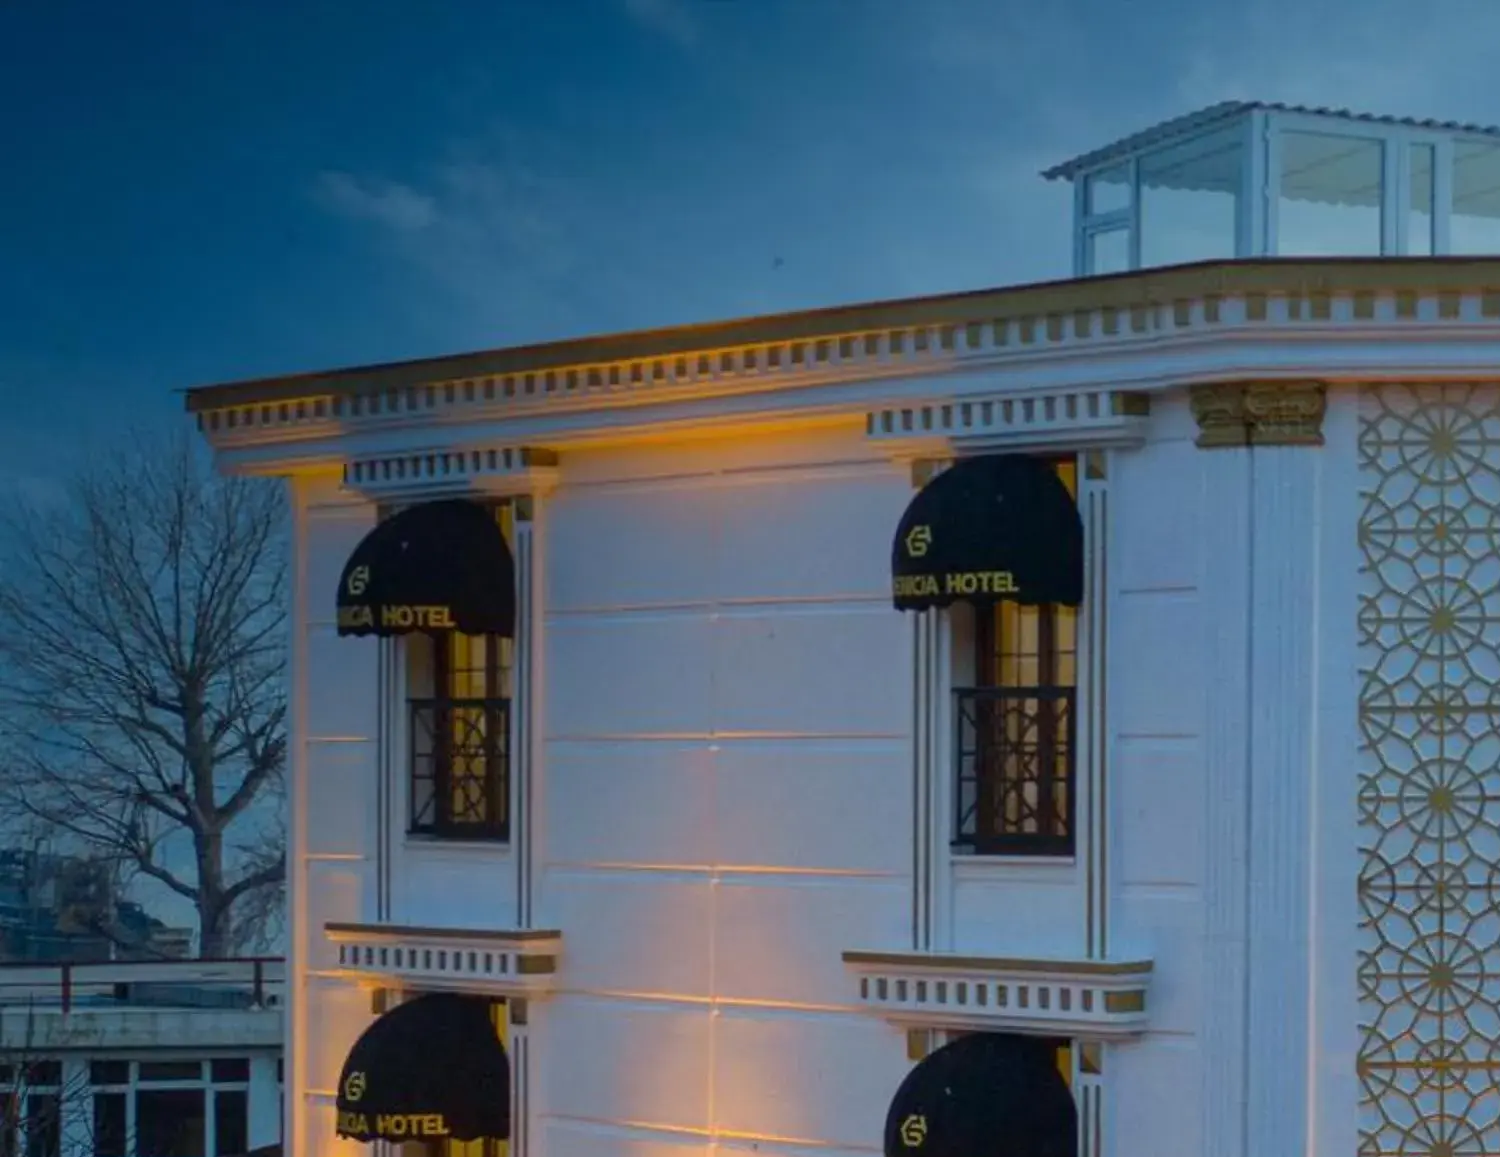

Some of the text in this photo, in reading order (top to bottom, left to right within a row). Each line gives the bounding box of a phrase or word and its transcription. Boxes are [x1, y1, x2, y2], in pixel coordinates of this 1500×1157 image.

[946, 570, 1020, 595] HOTEL
[381, 604, 456, 628] HOTEL
[376, 1113, 451, 1136] HOTEL
